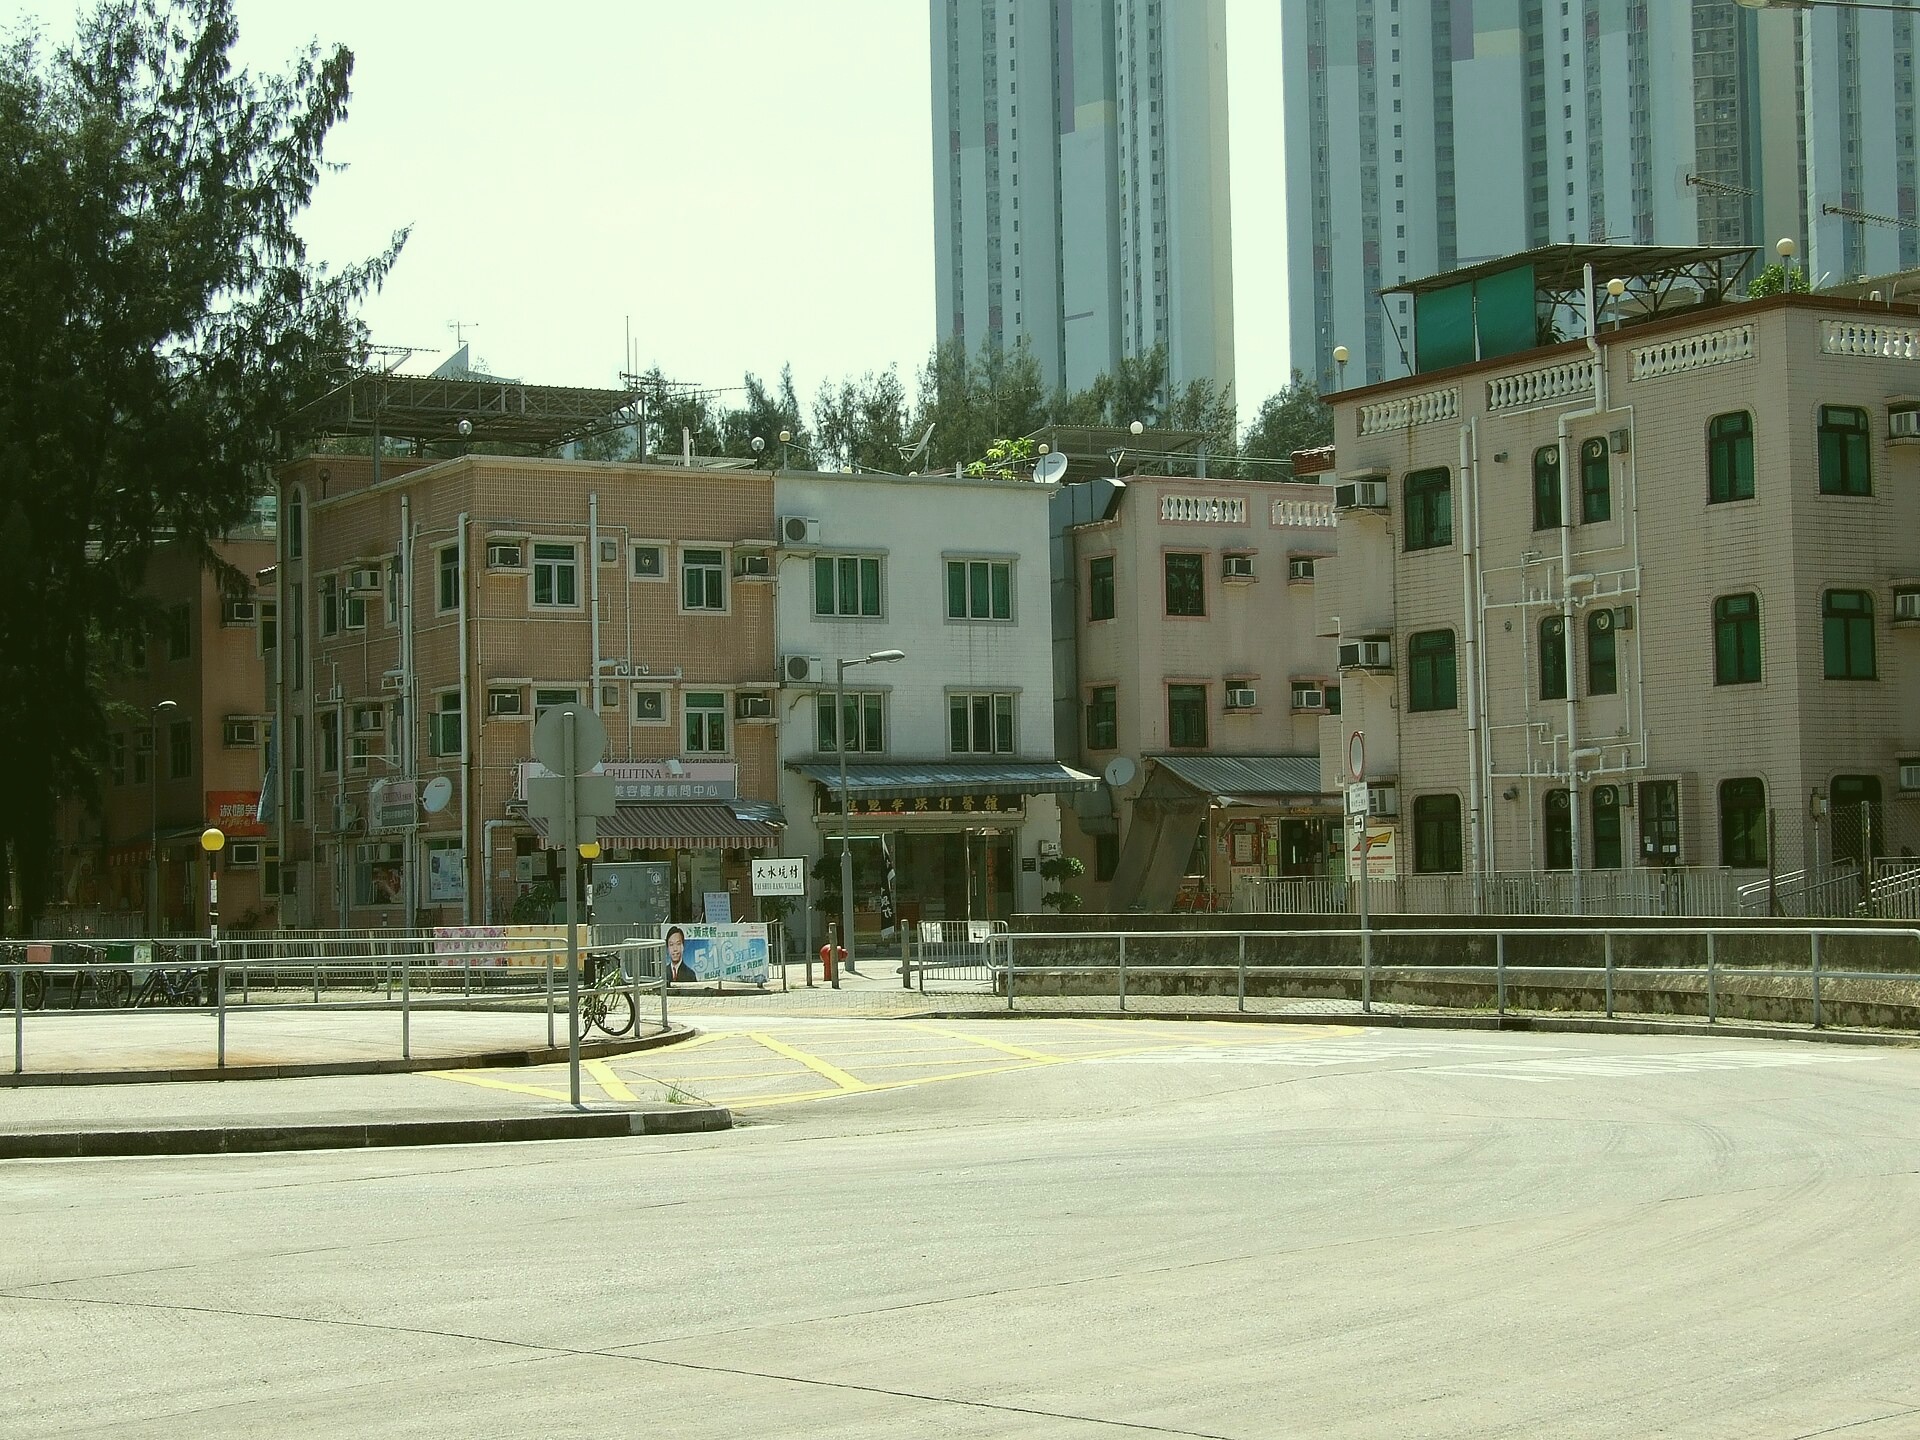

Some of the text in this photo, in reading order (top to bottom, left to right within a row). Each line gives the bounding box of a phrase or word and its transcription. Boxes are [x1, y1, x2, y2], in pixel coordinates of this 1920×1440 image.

[604, 768, 662, 779] CHLITINA
[1047, 843, 1057, 851] 94
[757, 864, 798, 879] 大水坑村
[692, 940, 735, 973] 516
